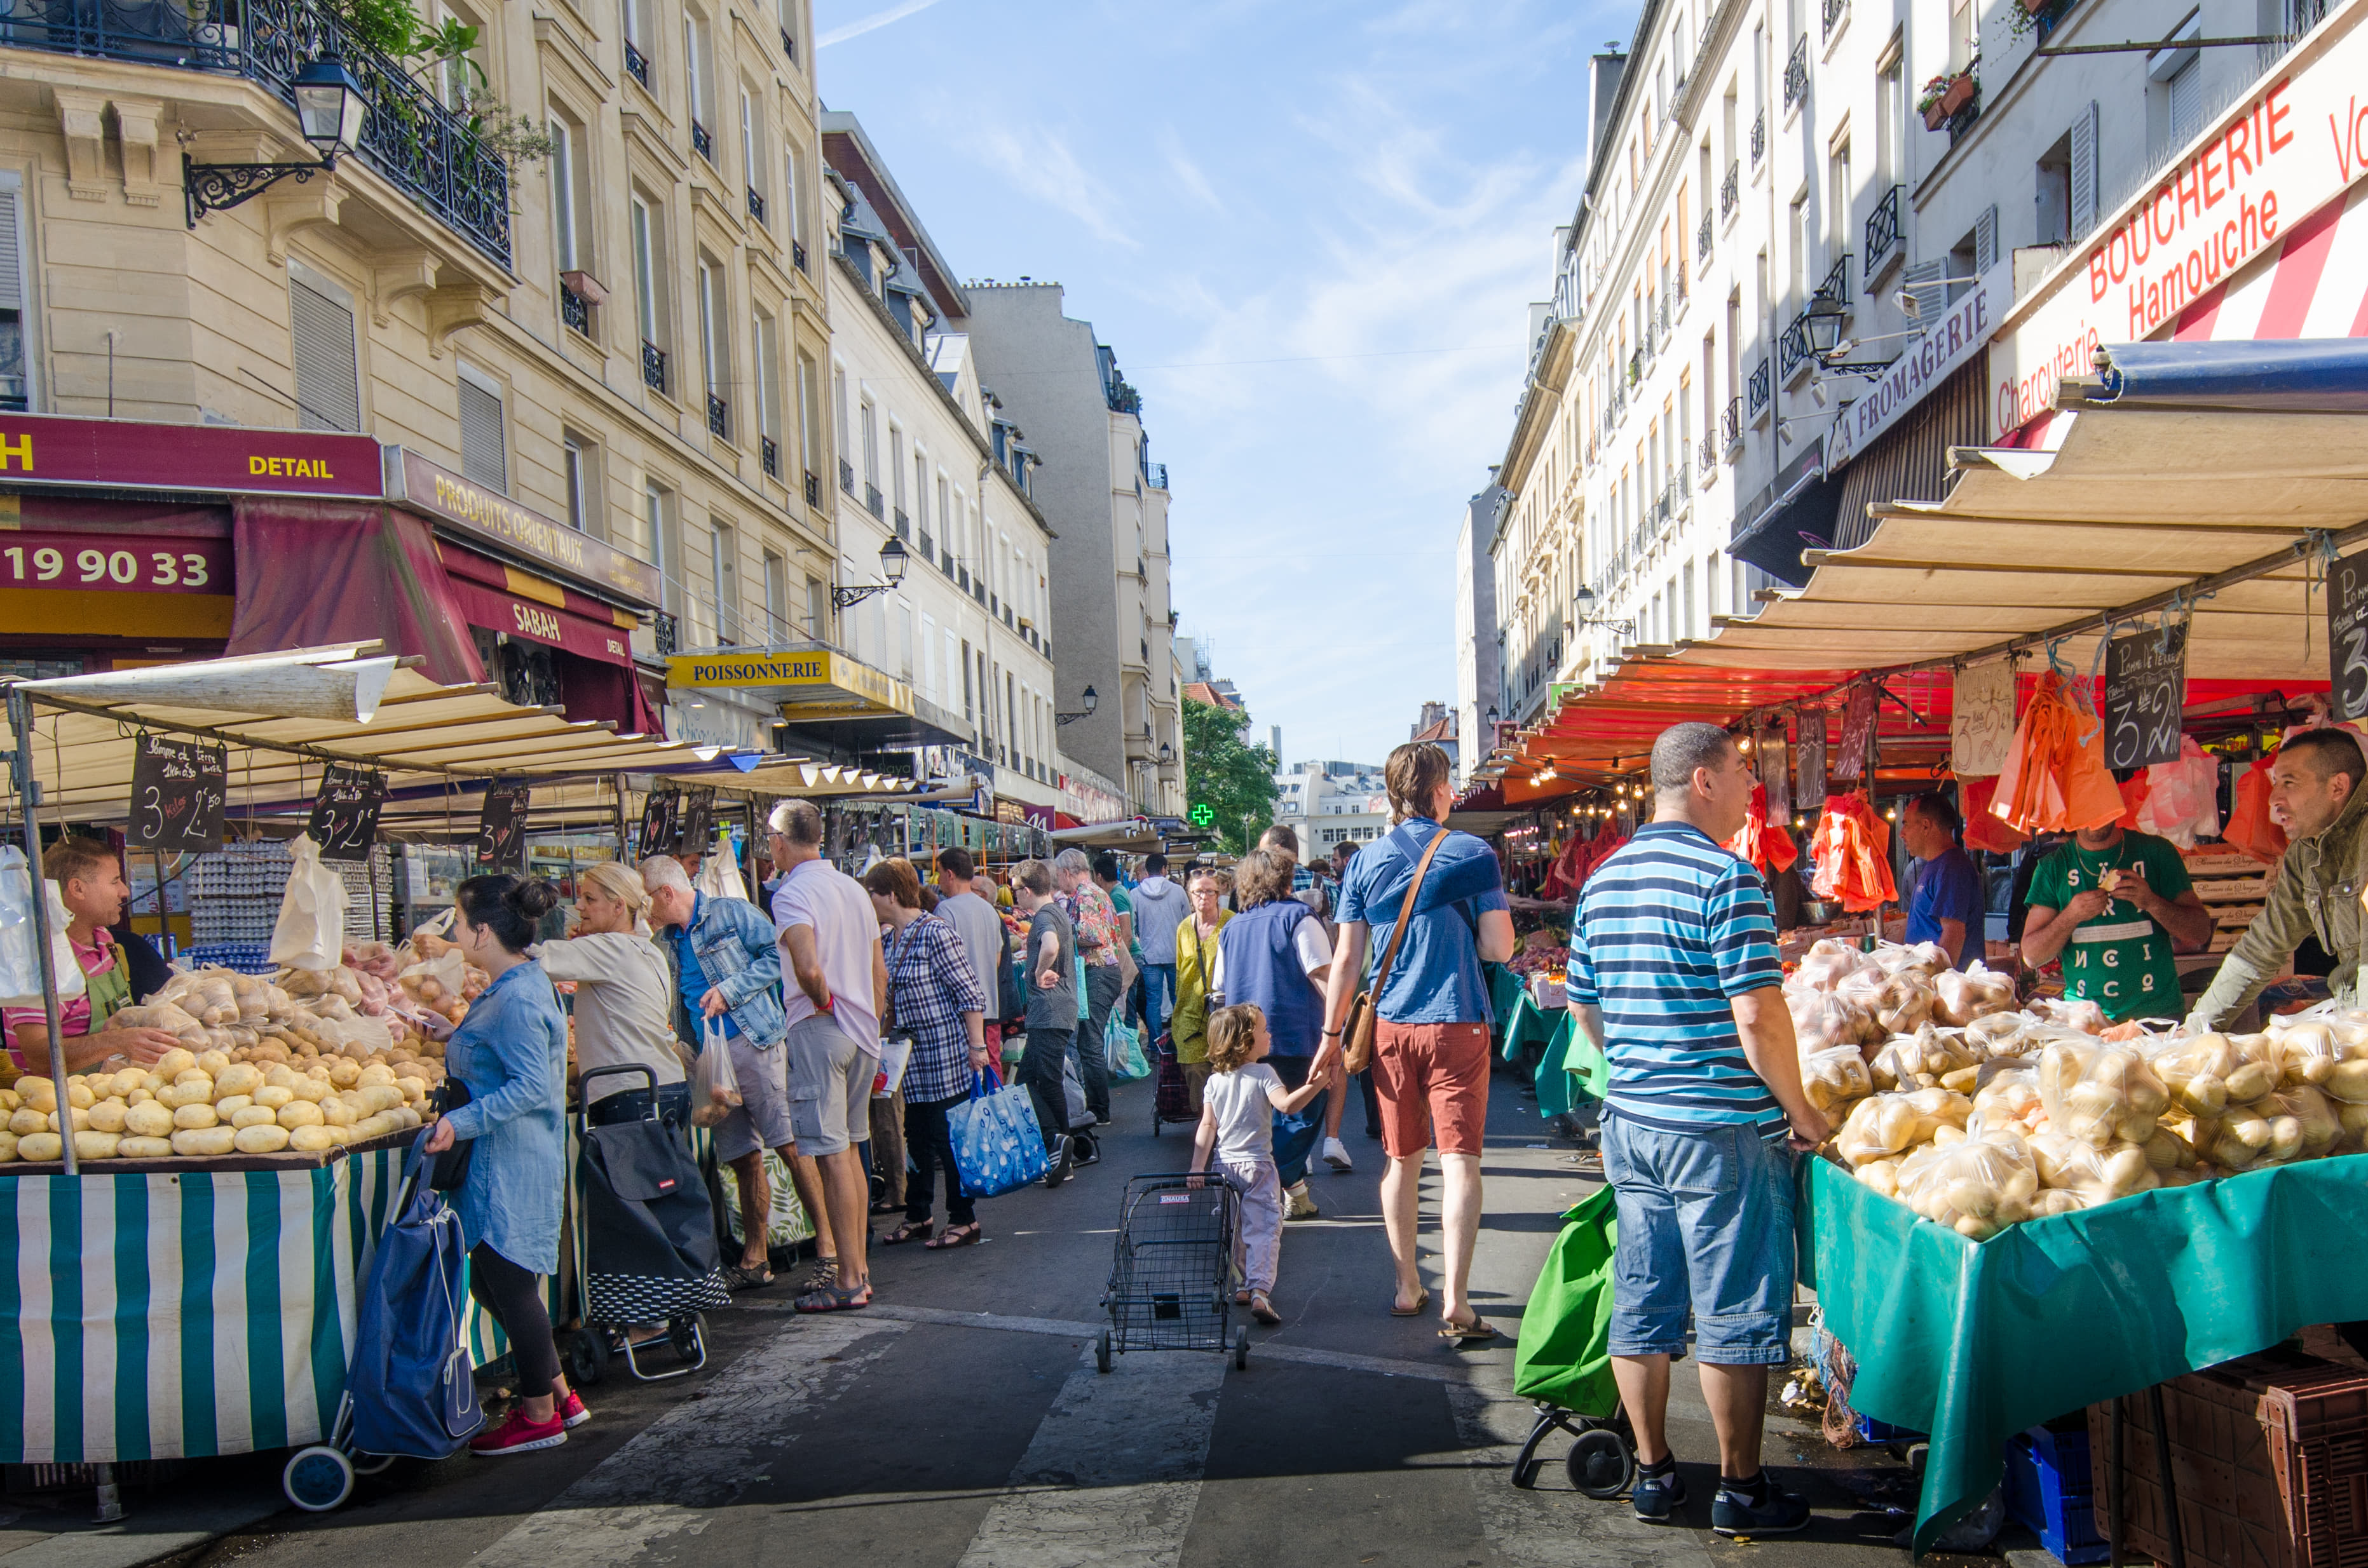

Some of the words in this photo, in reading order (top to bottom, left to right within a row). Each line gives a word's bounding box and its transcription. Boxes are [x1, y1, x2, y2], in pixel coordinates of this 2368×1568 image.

[2089, 76, 2294, 304] BOUCHERIE
[2128, 189, 2278, 342] Hamouche
[1858, 288, 1988, 437] FROMAGERIE
[1997, 320, 2099, 435] Charcuterie
[248, 456, 333, 479] DETAIL
[435, 474, 511, 536] PRODUITS
[512, 511, 584, 569] ORIENTAUX
[4, 546, 64, 581] 19
[76, 549, 137, 583] 90
[151, 552, 208, 586] 33
[513, 603, 561, 642] SABAH
[606, 639, 625, 657] DETAIL
[693, 662, 822, 681] POISSONNERIE
[146, 738, 175, 759] Pomme
[195, 745, 216, 764] terre
[2113, 701, 2139, 767] 3
[143, 786, 163, 839] 3
[320, 809, 336, 851] 3
[481, 825, 494, 855] 3
